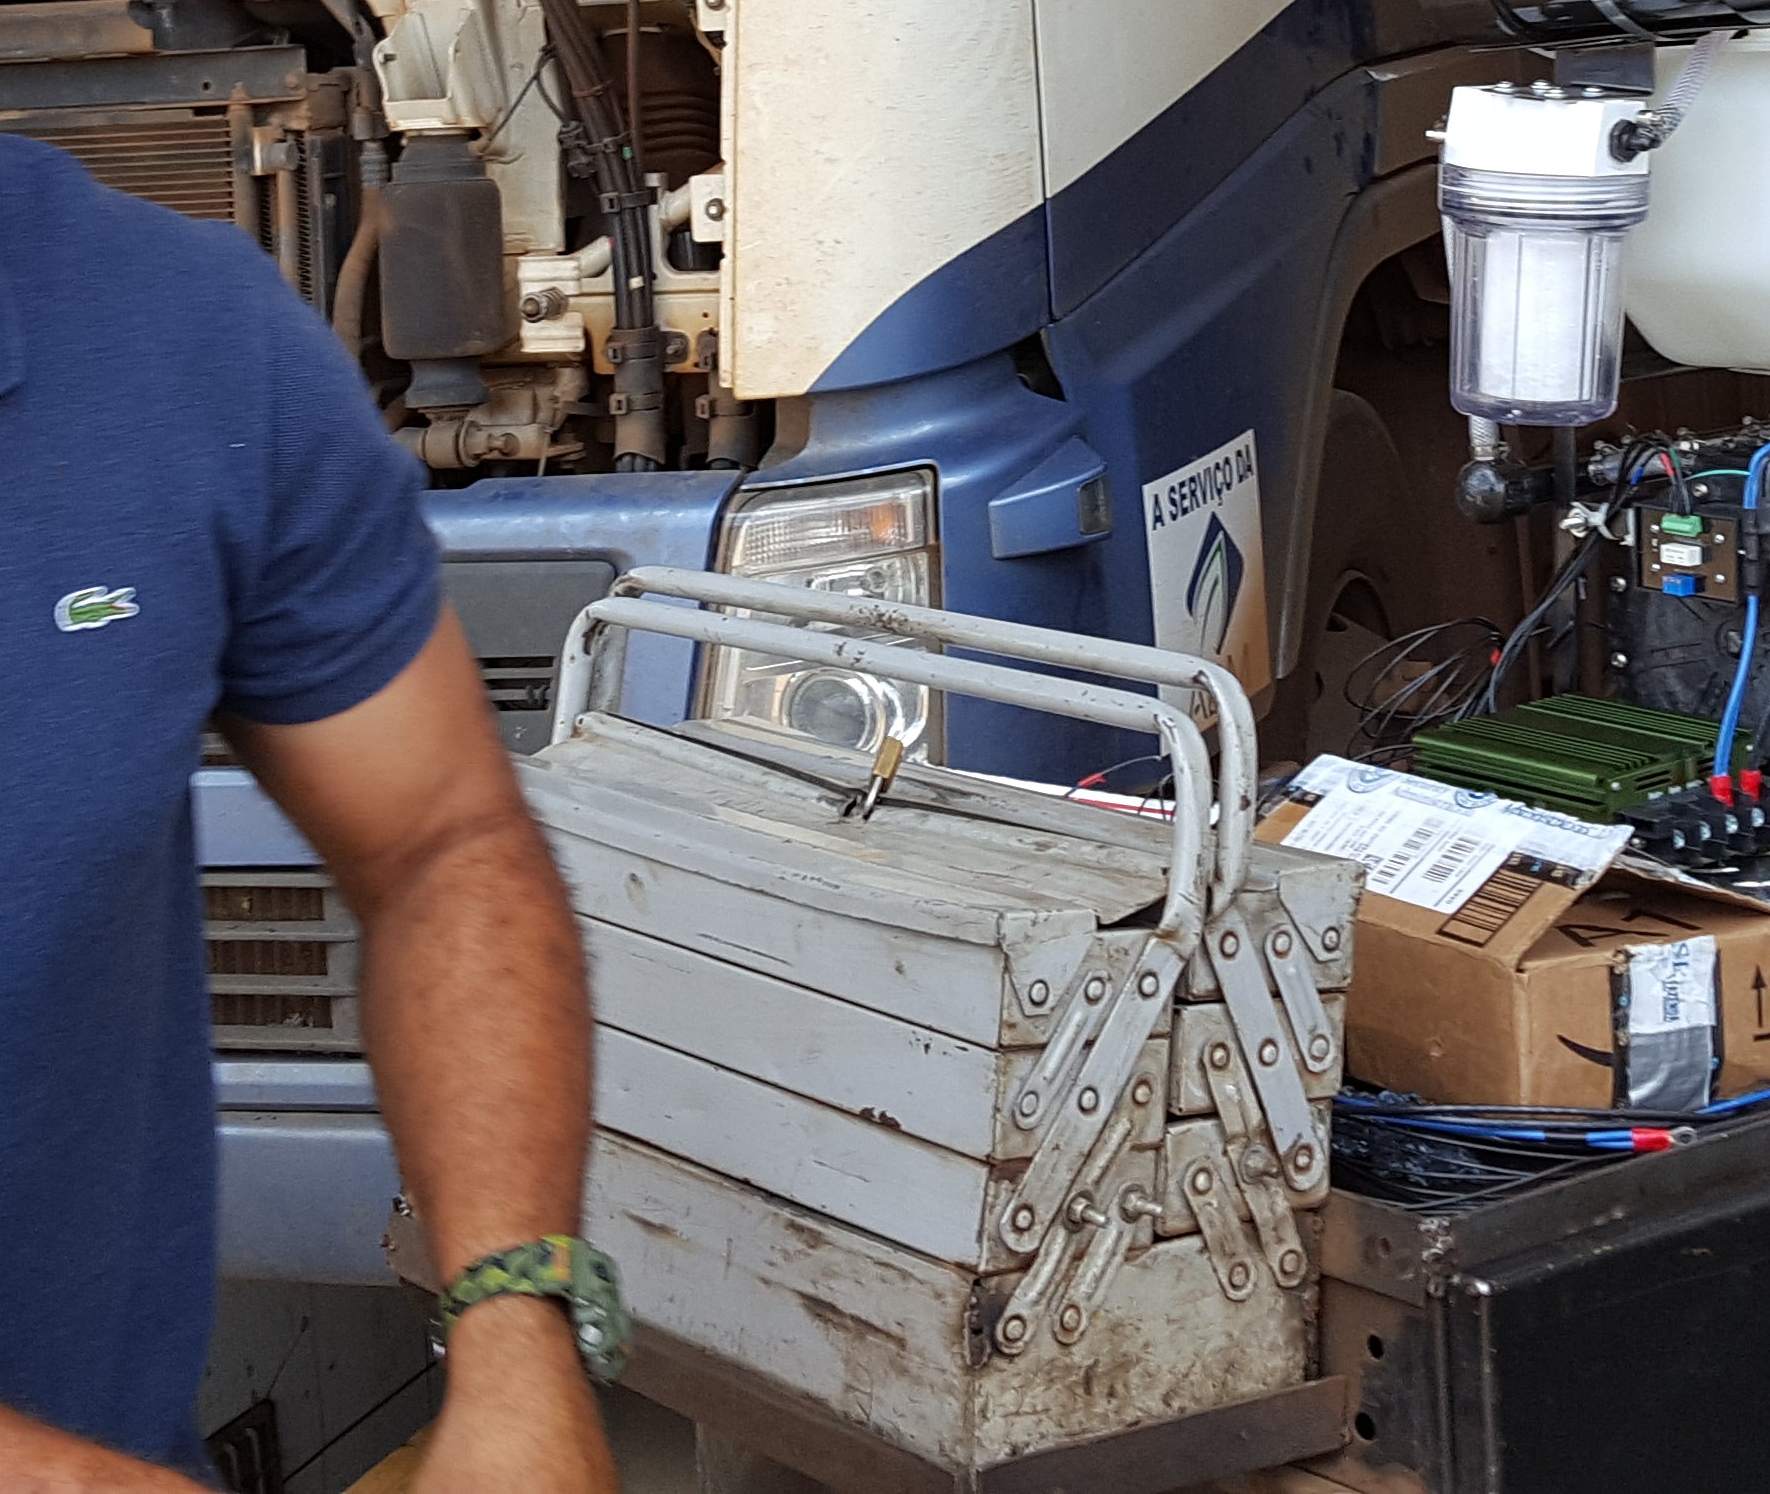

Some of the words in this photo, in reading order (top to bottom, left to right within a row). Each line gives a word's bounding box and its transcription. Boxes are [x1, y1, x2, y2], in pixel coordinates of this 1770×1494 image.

[1152, 493, 1166, 531] A
[1168, 456, 1233, 522] SERVIÇO
[1235, 444, 1254, 484] DA
